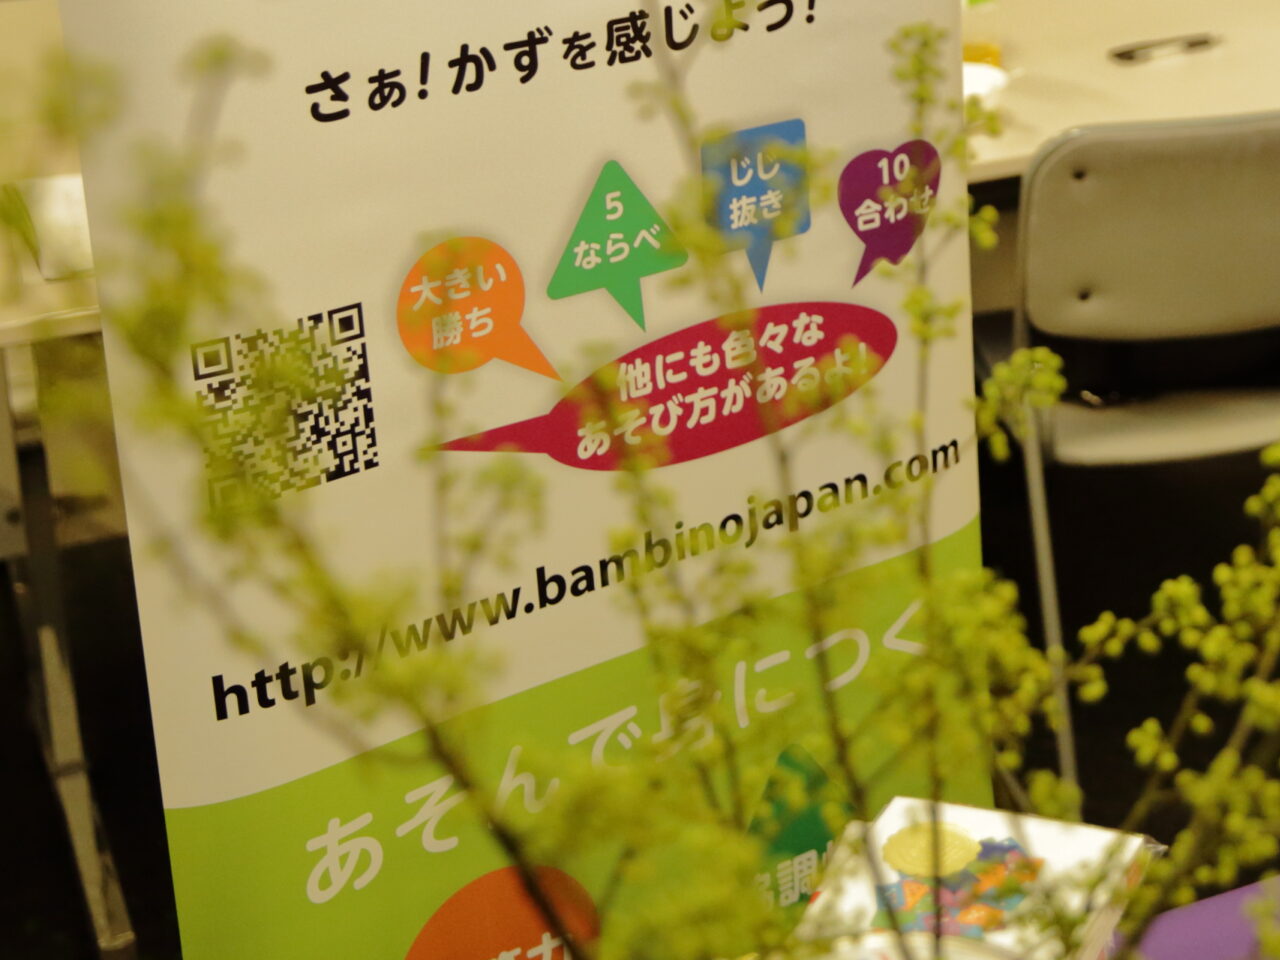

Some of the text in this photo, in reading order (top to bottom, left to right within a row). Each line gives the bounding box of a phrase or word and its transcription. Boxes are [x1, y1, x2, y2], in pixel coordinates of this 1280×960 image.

[729, 150, 782, 188] じじ
[877, 152, 911, 187] 10
[604, 190, 625, 221] 5
[728, 189, 785, 230] 抜き
[853, 183, 937, 233] 合わせ
[573, 222, 663, 271] ならべ
[409, 261, 508, 312] 大きい
[431, 305, 496, 350] 勝ち
[615, 312, 826, 402] 他にも色々な
[211, 437, 963, 722] http://www.bambinojapan.com
